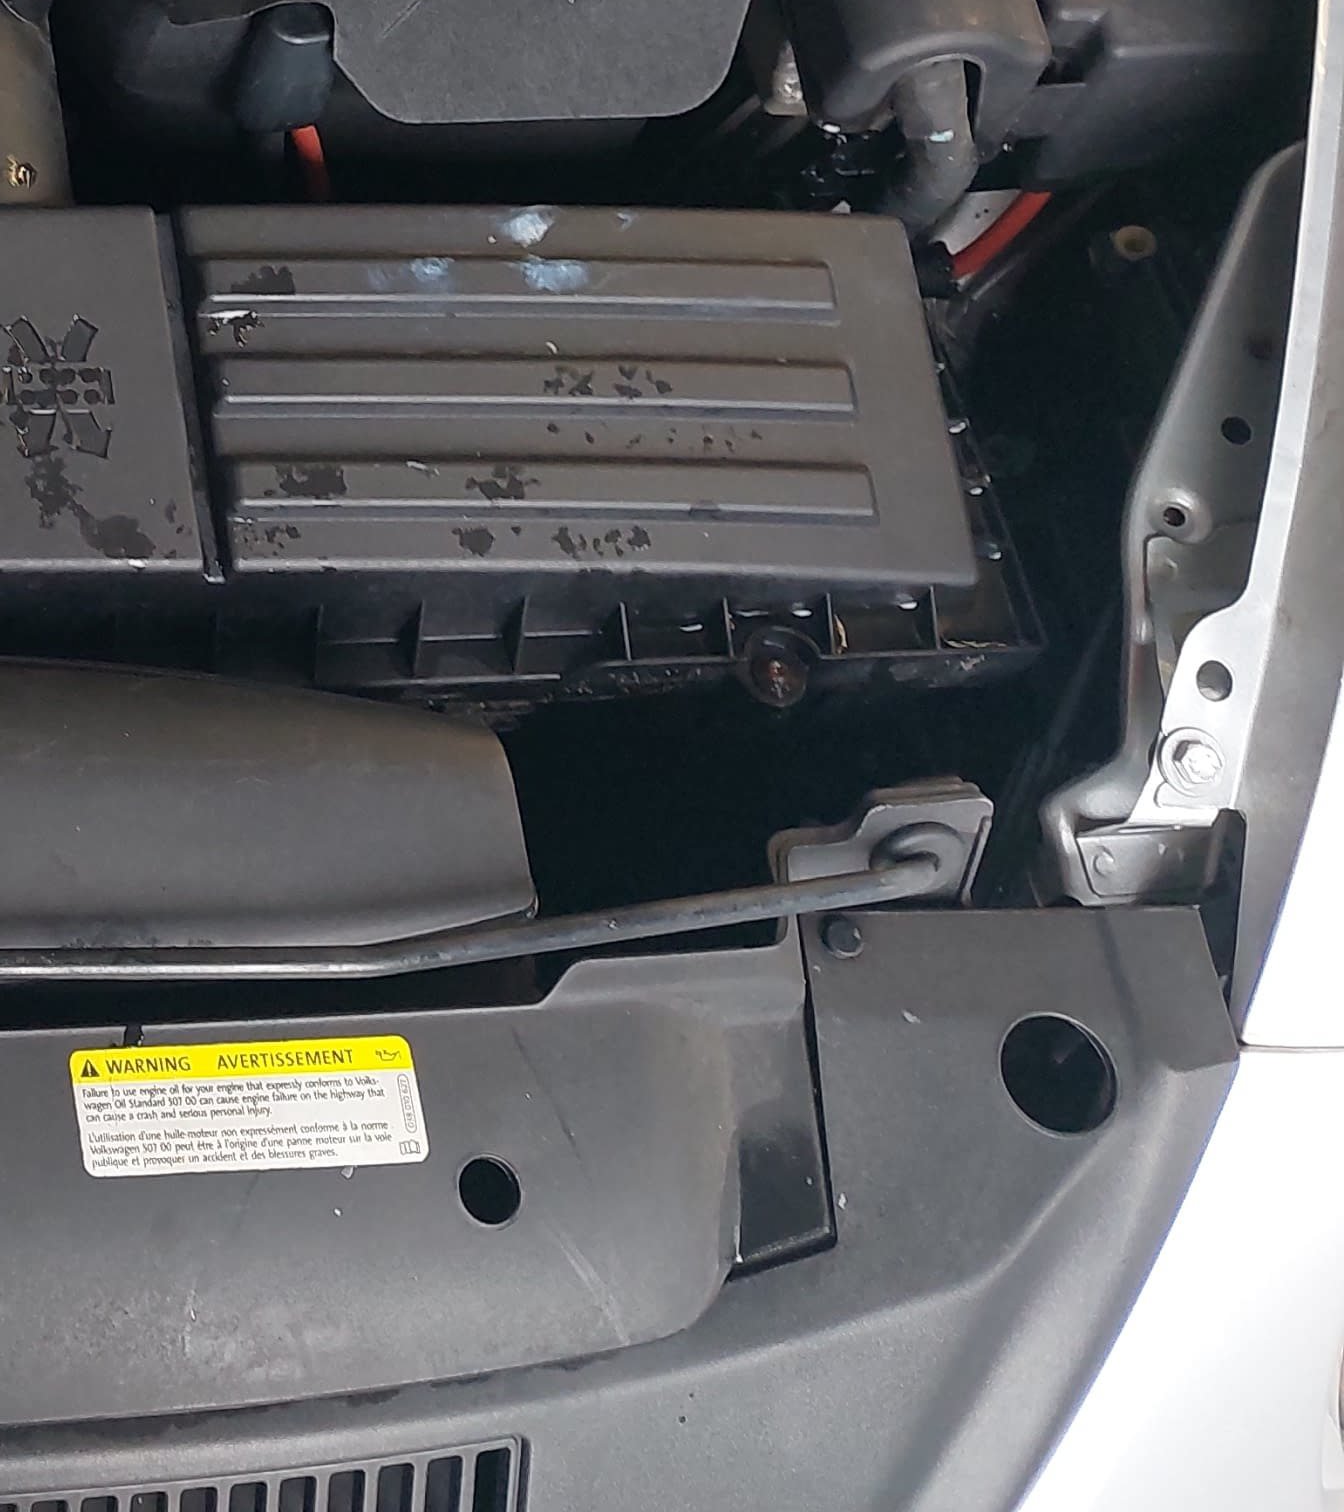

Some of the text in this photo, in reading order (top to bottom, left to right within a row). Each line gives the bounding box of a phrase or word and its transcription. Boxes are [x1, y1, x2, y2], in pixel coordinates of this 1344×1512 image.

[105, 1048, 354, 1075] WARNING AVERTISSEMENT
[82, 1087, 108, 1098] Failure
[112, 1086, 120, 1097] to
[122, 1088, 137, 1096] use
[139, 1084, 167, 1098] engine
[169, 1084, 180, 1094] oil
[182, 1083, 192, 1094] for
[196, 1085, 212, 1096] your
[217, 1081, 244, 1095] engine
[246, 1081, 262, 1091] that
[266, 1079, 302, 1093] expressly
[304, 1078, 342, 1089] conforms
[344, 1077, 353, 1087] to
[84, 1102, 112, 1113] wagen
[114, 1099, 126, 1109] Oil
[128, 1097, 166, 1109] Standard
[185, 1096, 196, 1106] 00
[216, 1096, 239, 1104] cause
[242, 1093, 270, 1106] engine
[272, 1092, 298, 1102] failure
[300, 1093, 312, 1101] on
[314, 1090, 328, 1100] the
[330, 1089, 365, 1102] highway
[367, 1088, 385, 1097] that
[86, 1115, 100, 1123] can
[103, 1114, 126, 1122] cause
[129, 1113, 134, 1121] a
[136, 1110, 158, 1120] crash
[160, 1109, 176, 1119] and
[178, 1108, 208, 1118] serious
[210, 1106, 244, 1120] personal
[138, 1129, 162, 1141] d'une
[221, 1128, 238, 1137] non
[300, 1121, 340, 1133] conforme
[350, 1120, 358, 1130] la
[361, 1121, 388, 1130] norme
[90, 1143, 140, 1158] Volkswagen
[174, 1140, 194, 1154] peut
[260, 1135, 284, 1147] d'une
[286, 1136, 312, 1148] panne
[316, 1132, 346, 1144] moteur
[348, 1134, 362, 1142] sur
[364, 1131, 372, 1142] la
[375, 1130, 392, 1141] voie
[92, 1157, 128, 1170] publique
[132, 1156, 140, 1165] et
[142, 1156, 184, 1168] provoquer
[202, 1151, 236, 1162] accident
[240, 1151, 248, 1160] et
[251, 1150, 266, 1160] des
[268, 1148, 306, 1159] blessures
